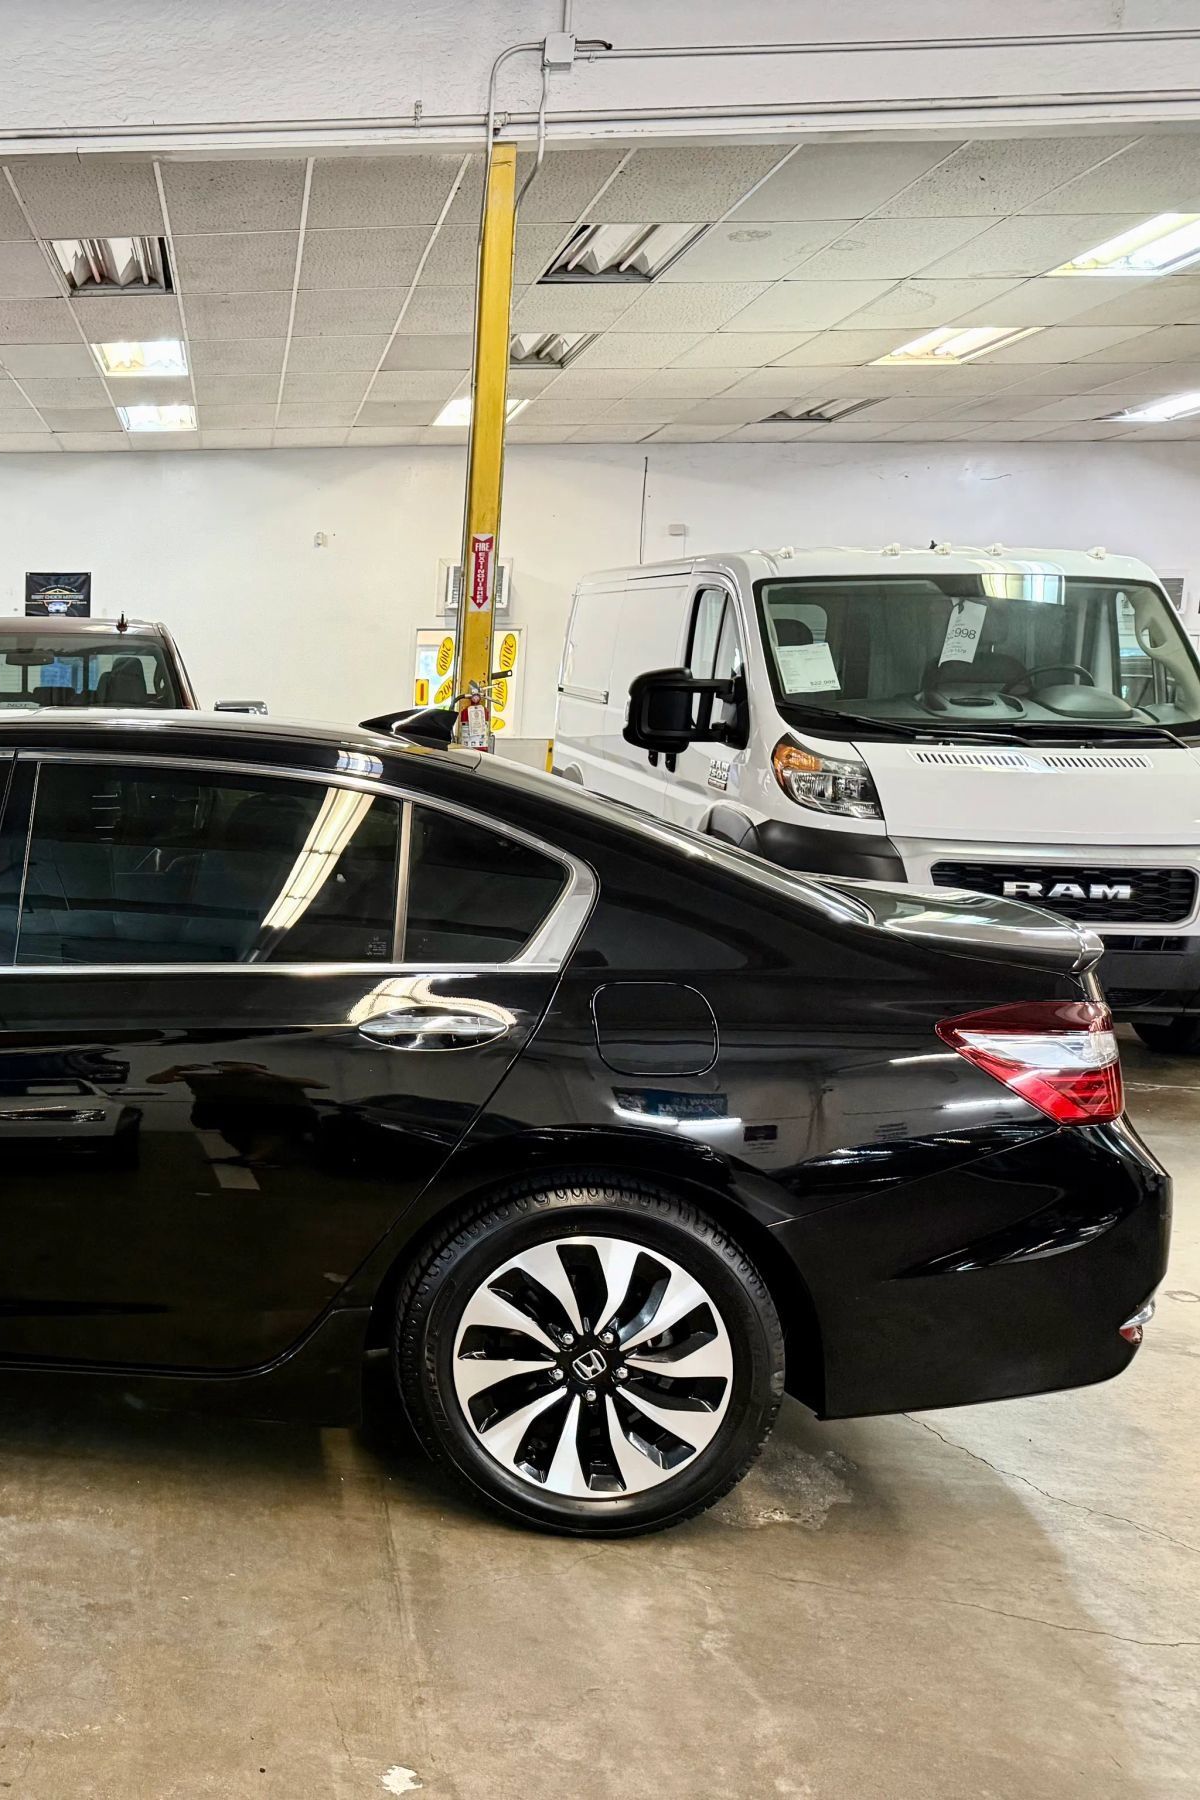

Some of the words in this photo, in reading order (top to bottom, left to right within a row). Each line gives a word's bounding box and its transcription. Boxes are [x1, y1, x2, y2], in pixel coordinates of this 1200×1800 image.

[475, 542, 490, 552] FIRE
[476, 551, 486, 604] EXTINGUISHER
[1003, 881, 1131, 900] RAM
